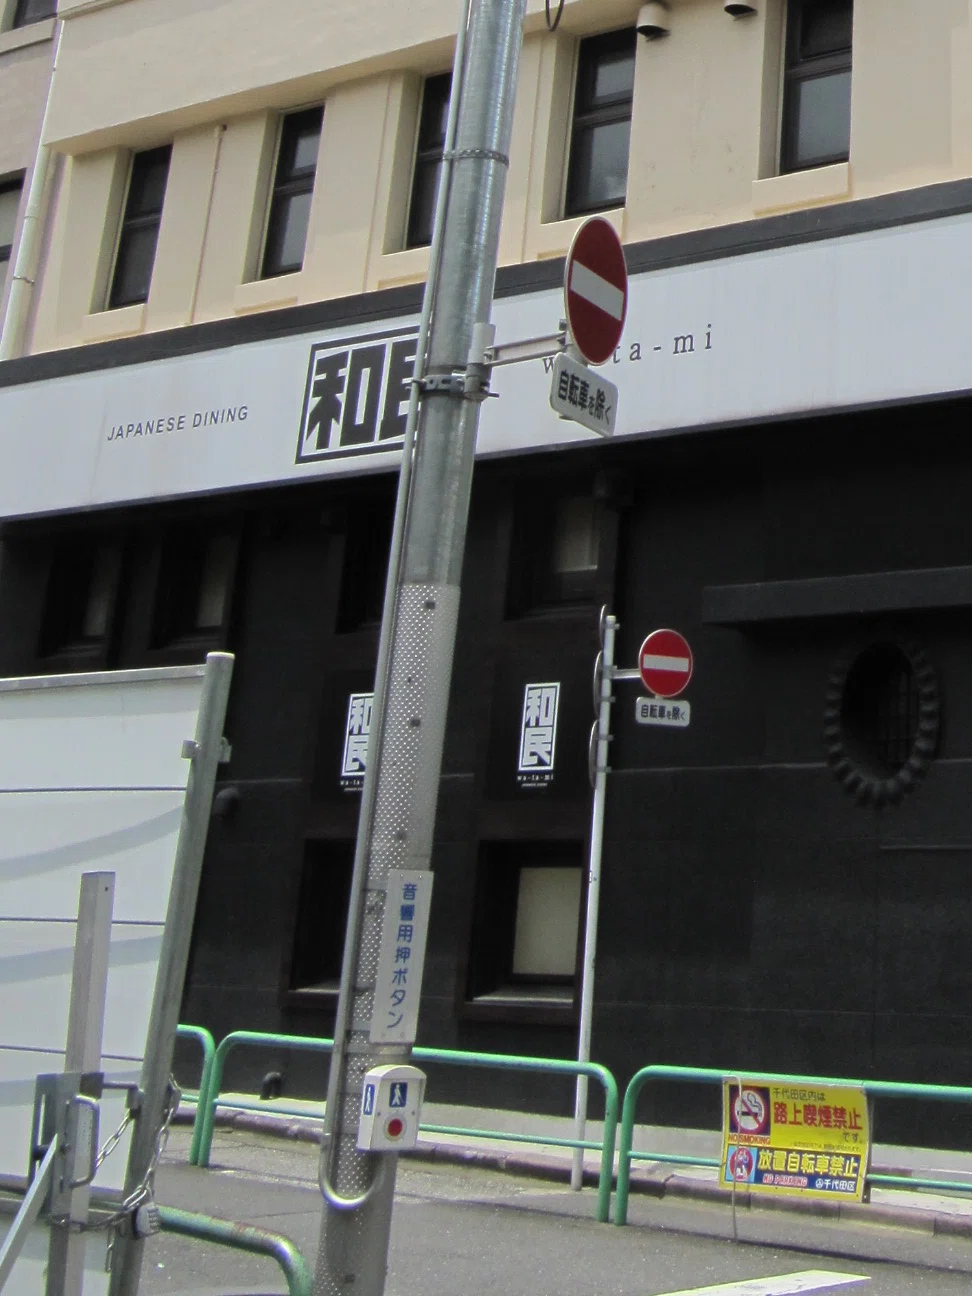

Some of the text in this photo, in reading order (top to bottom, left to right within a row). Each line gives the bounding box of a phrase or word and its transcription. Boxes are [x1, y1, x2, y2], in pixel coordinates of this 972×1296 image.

[557, 368, 612, 425] 自転車を除く
[107, 405, 249, 441] JAPANESE DINING
[521, 686, 557, 767] 和民
[640, 703, 687, 722] 自転車を除く
[773, 1101, 863, 1131] 路上喫煙禁止
[757, 1148, 860, 1178] 放置自転車禁止
[823, 1178, 856, 1192] 千代田区
